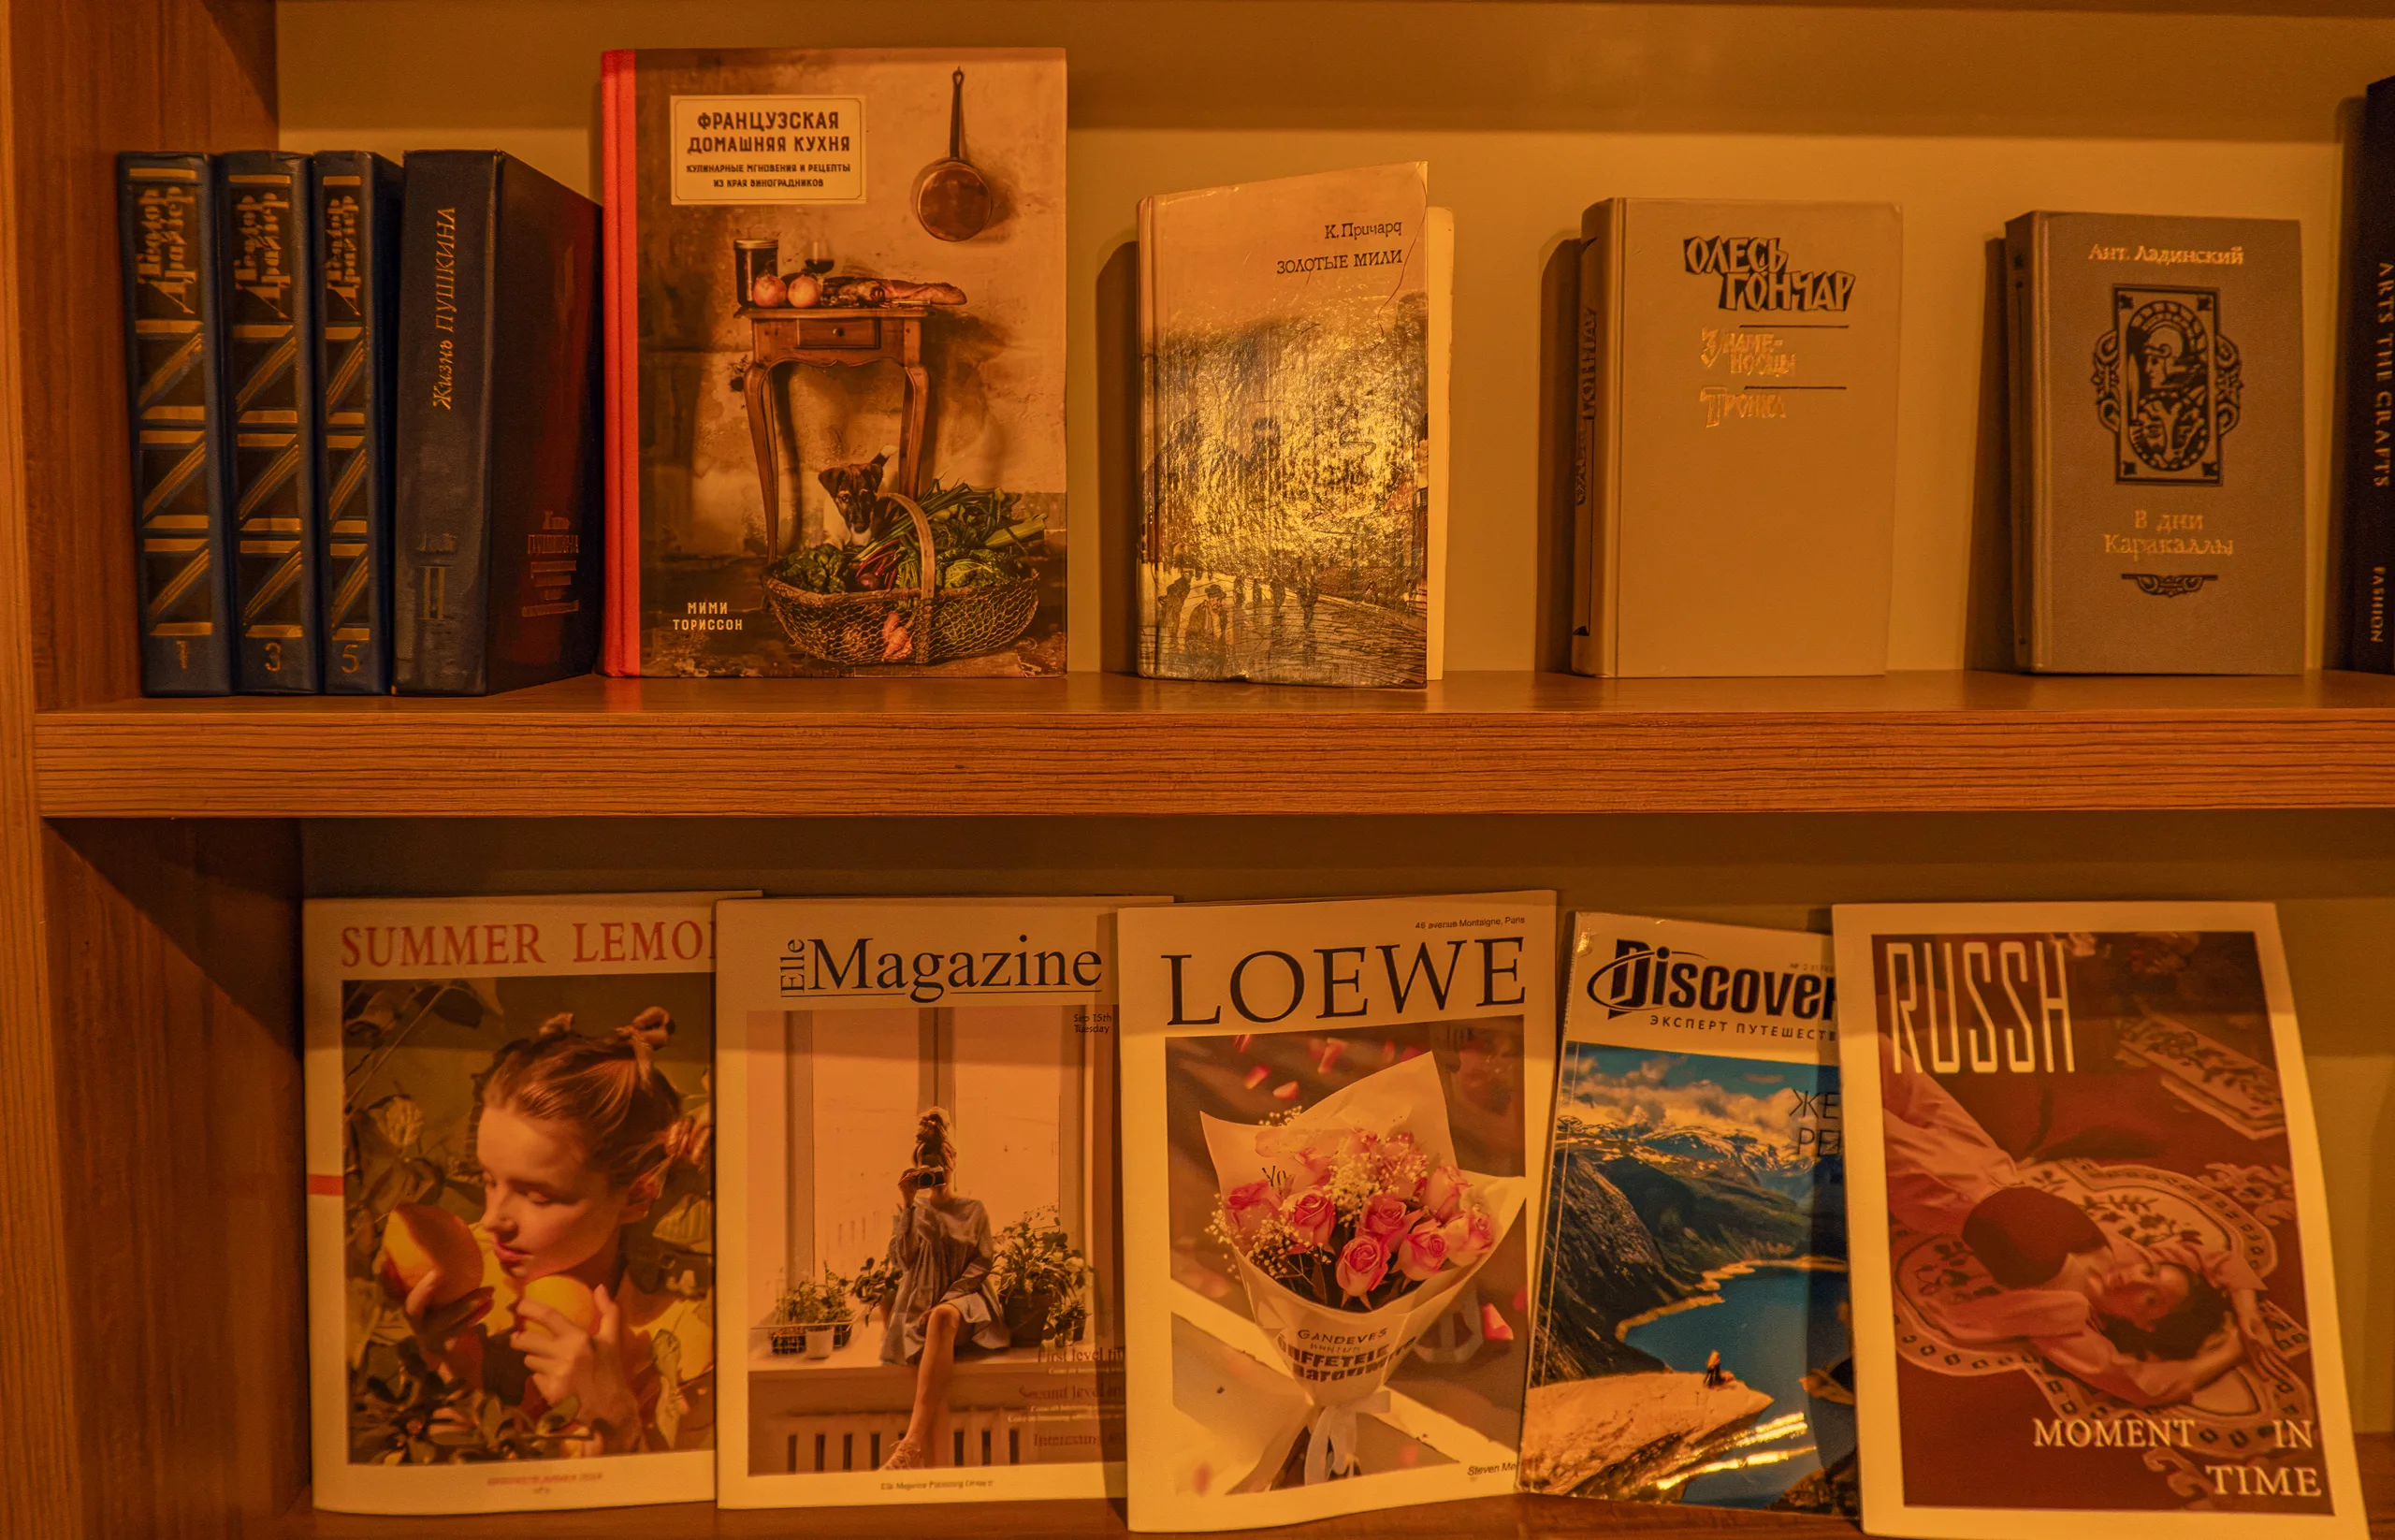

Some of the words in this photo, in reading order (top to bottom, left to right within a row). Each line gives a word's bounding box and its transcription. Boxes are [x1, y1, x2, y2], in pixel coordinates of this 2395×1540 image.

[698, 110, 839, 132] ФРАНЦУЗСКАЯ
[687, 137, 787, 154] ДОМАШНЯЯ
[793, 136, 850, 153] КУХНЯ
[686, 164, 744, 173] КУЛИНАРНЫЕ
[747, 164, 797, 172] МГНОВЕНИЯ
[799, 164, 806, 172] И
[808, 163, 851, 174] РЕЦЕПТЫ
[713, 179, 725, 188] ИЗ
[726, 179, 748, 187] КРАЯ
[749, 178, 824, 188] ВИНОГРАДНИКОВ
[435, 207, 457, 333] ПУШКИНА
[1276, 254, 1348, 274] ЗОЛОТЫЕ
[1353, 249, 1403, 268] МИЛИ
[1683, 235, 1789, 275] ОЛЕСЬ
[2087, 243, 2130, 261] Ант.
[2134, 244, 2244, 267] Ладинский
[1718, 269, 1856, 312] ГОНЧАР
[2376, 262, 2394, 324] ARTS
[2374, 333, 2394, 382] THE
[432, 339, 455, 410] Жизнь
[2373, 391, 2393, 487] CRAFTS
[2134, 509, 2147, 529] В
[2104, 533, 2233, 561] Каракаллы
[687, 602, 728, 615] МИМИ
[673, 618, 743, 631] ТОРИССОН
[175, 640, 187, 671] 1
[264, 642, 281, 673] 3
[341, 644, 359, 674] 5
[1428, 921, 1458, 929] avenue
[1459, 918, 1502, 927] Montaigne,
[1504, 916, 1526, 924] Paris
[341, 923, 546, 967] SUMMER
[572, 920, 716, 964] LEMO
[780, 938, 806, 994] Elle
[806, 934, 1102, 1003] Magazine
[1160, 936, 1526, 1026] LOEWE
[1093, 1012, 1111, 1023] 15th
[1886, 940, 2075, 1074] RUSSH
[1073, 1024, 1110, 1034] Tuesday
[1649, 1015, 1728, 1032] ЭКСПЕРТ
[2032, 1417, 2195, 1447] MOMENT
[2272, 1419, 2314, 1448] IN
[1467, 1465, 1500, 1476] Steven
[2206, 1465, 2322, 1497] TIME
